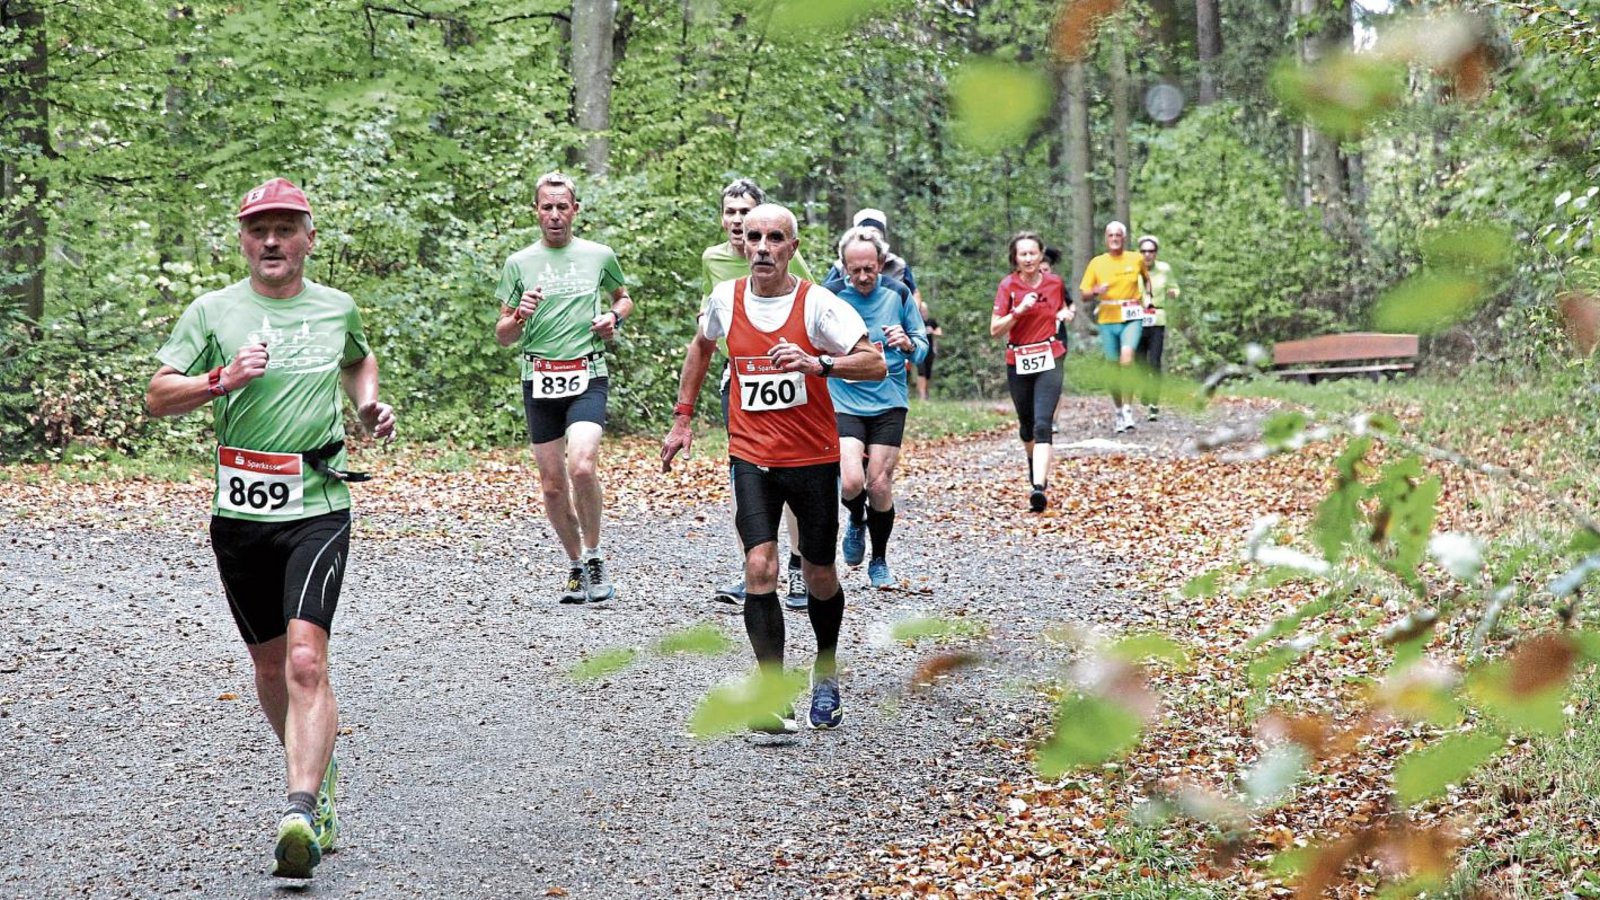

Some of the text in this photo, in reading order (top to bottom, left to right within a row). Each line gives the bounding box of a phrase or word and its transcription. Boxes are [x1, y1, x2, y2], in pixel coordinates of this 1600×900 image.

[1022, 355, 1046, 371] 857
[541, 375, 580, 395] 836
[744, 379, 796, 407] 760
[247, 459, 282, 472] Sparkasse
[229, 476, 290, 511] 869
